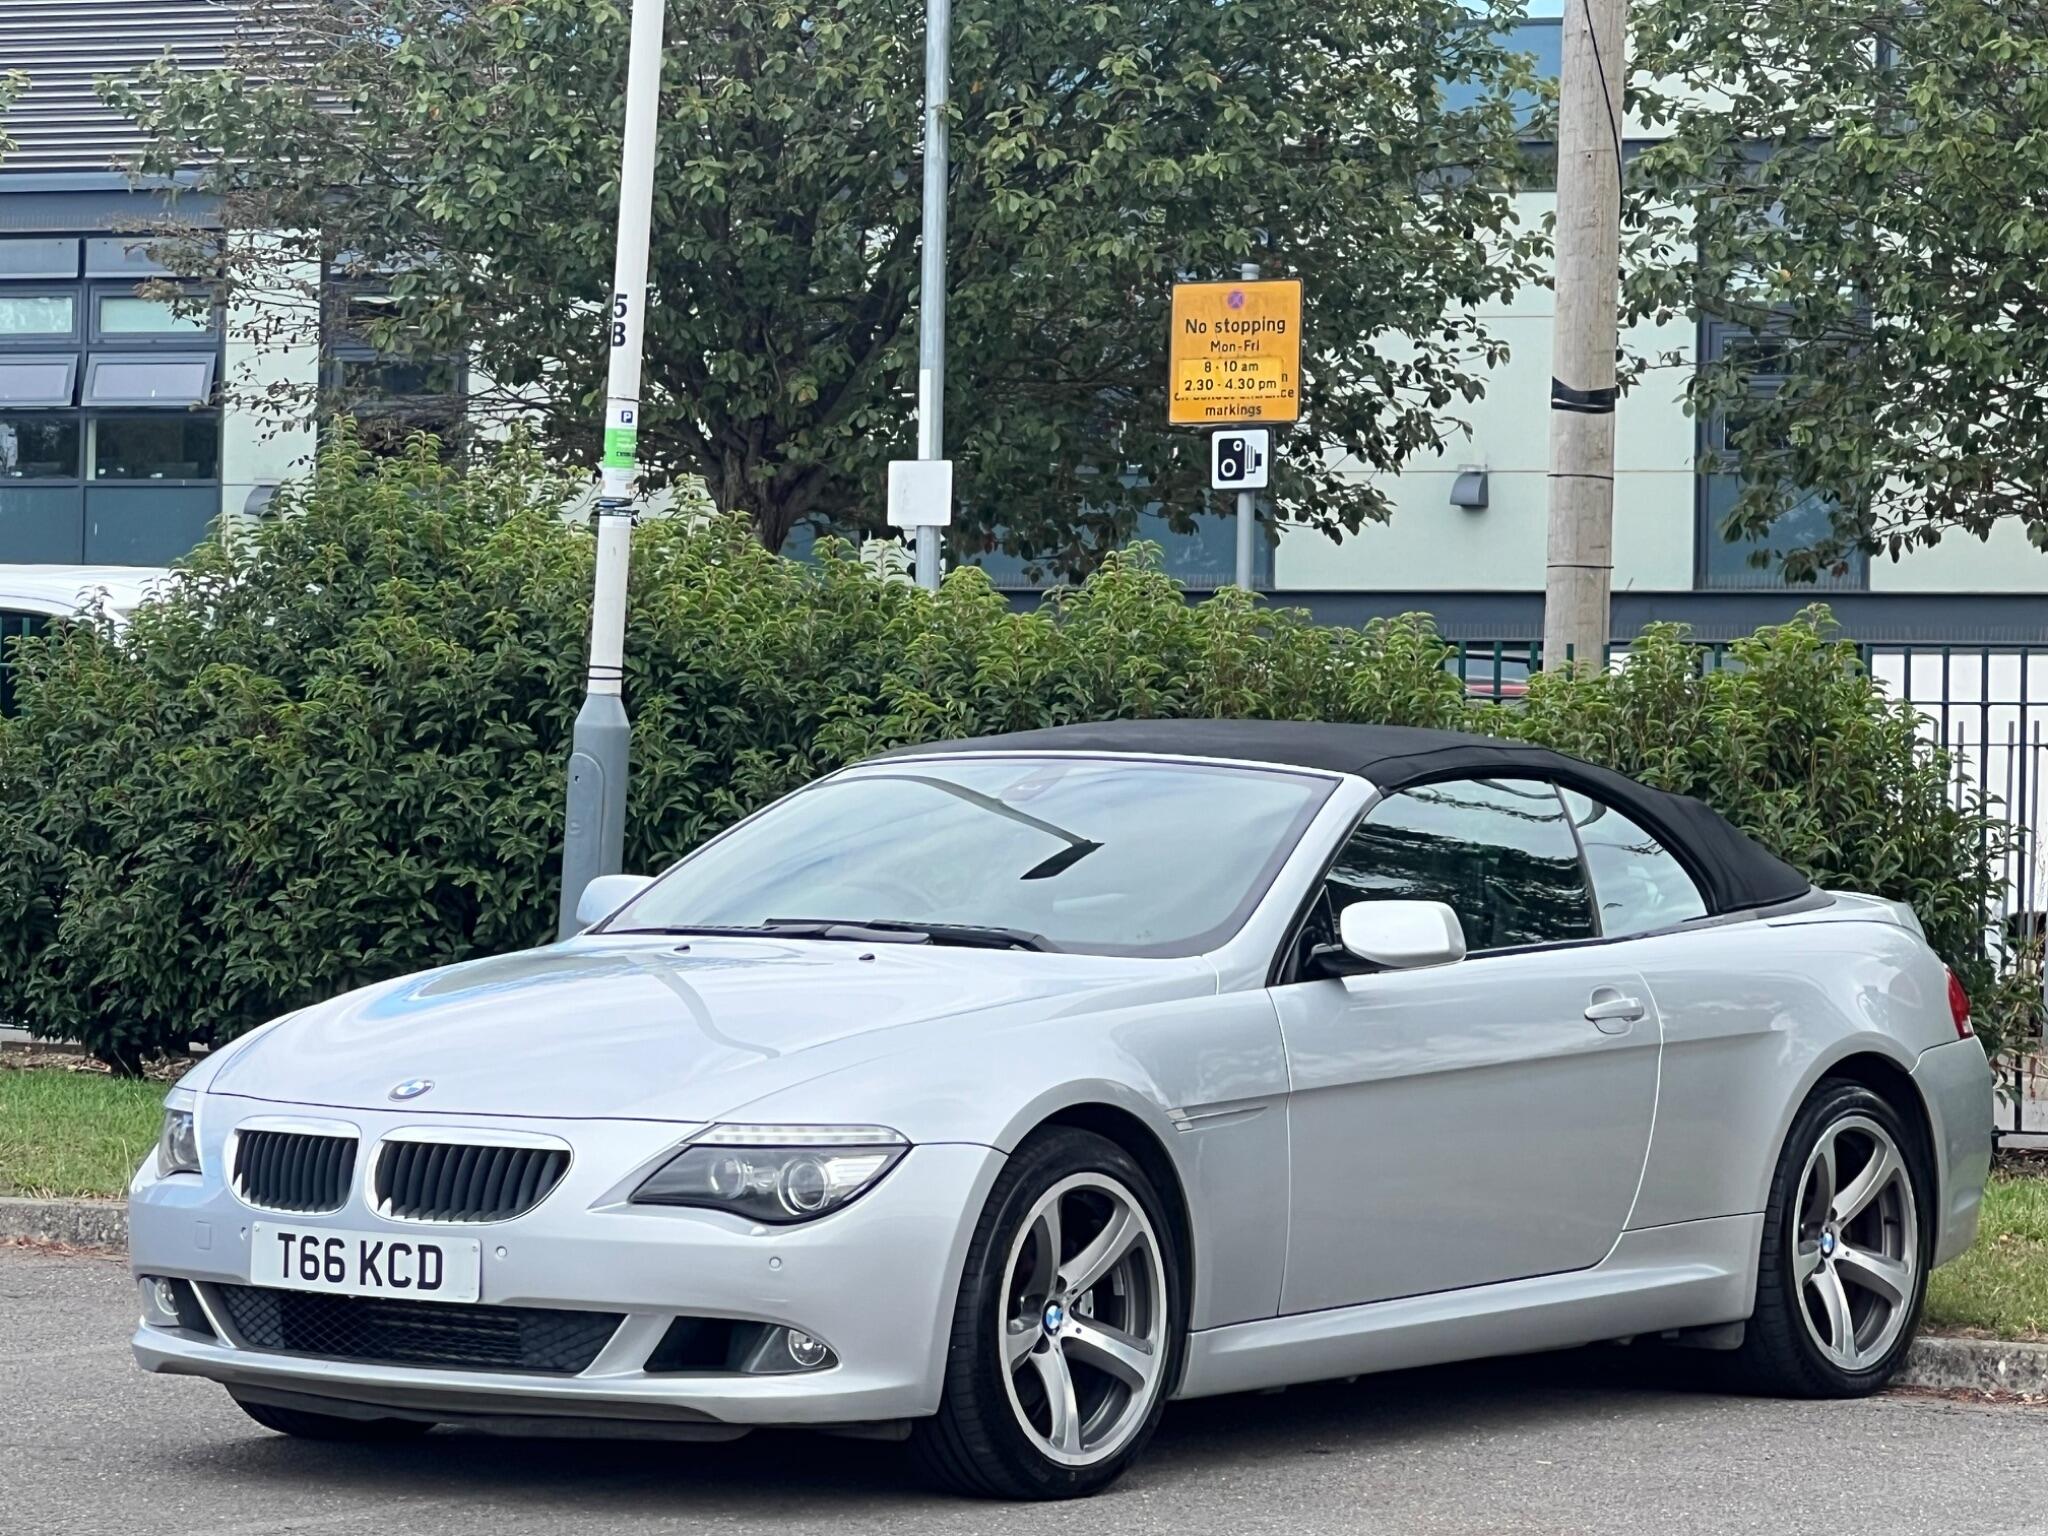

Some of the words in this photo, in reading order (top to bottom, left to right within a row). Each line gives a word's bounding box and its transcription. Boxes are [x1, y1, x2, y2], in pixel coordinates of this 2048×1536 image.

[1185, 318, 1207, 334] No
[1215, 316, 1286, 335] stopping
[1204, 361, 1212, 373] 8
[1224, 360, 1238, 372] 10
[1241, 362, 1259, 372] am
[1184, 378, 1214, 391] 2.30
[1224, 377, 1255, 390] 4.30
[1258, 380, 1277, 391] pm
[1205, 404, 1262, 417] markings
[277, 1232, 346, 1283] T66
[359, 1240, 443, 1291] KCD
